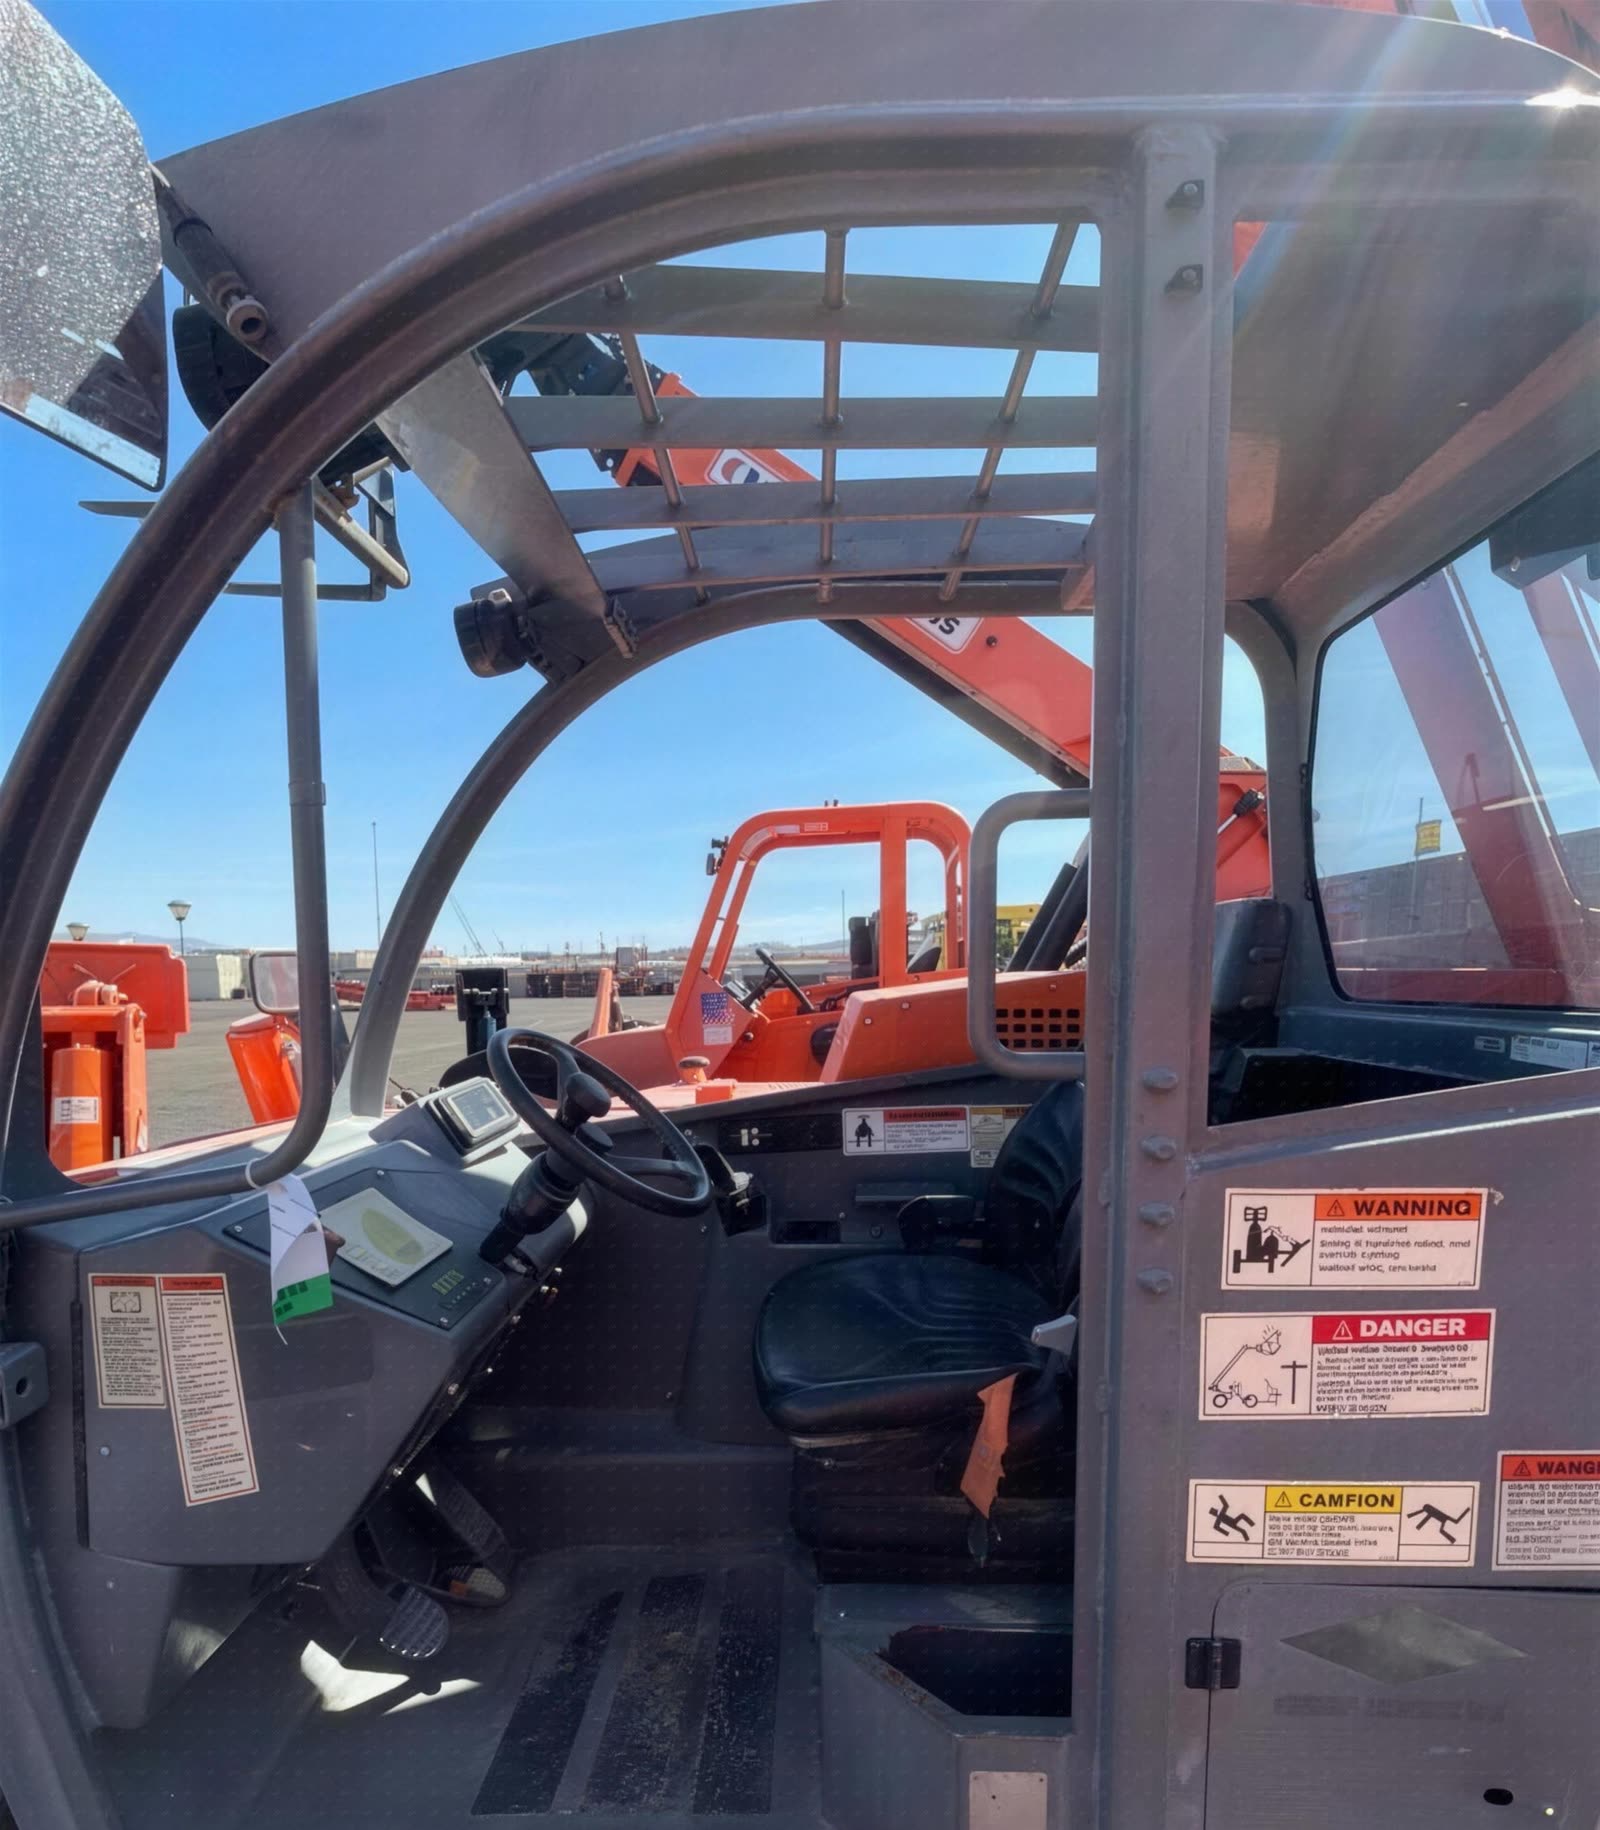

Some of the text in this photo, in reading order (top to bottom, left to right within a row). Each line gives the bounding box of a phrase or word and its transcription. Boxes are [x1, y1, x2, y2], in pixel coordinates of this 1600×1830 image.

[1359, 1317, 1467, 1338] DANGER
[1536, 1461, 1600, 1475] WANG
[1299, 1493, 1395, 1508] CAMFION
